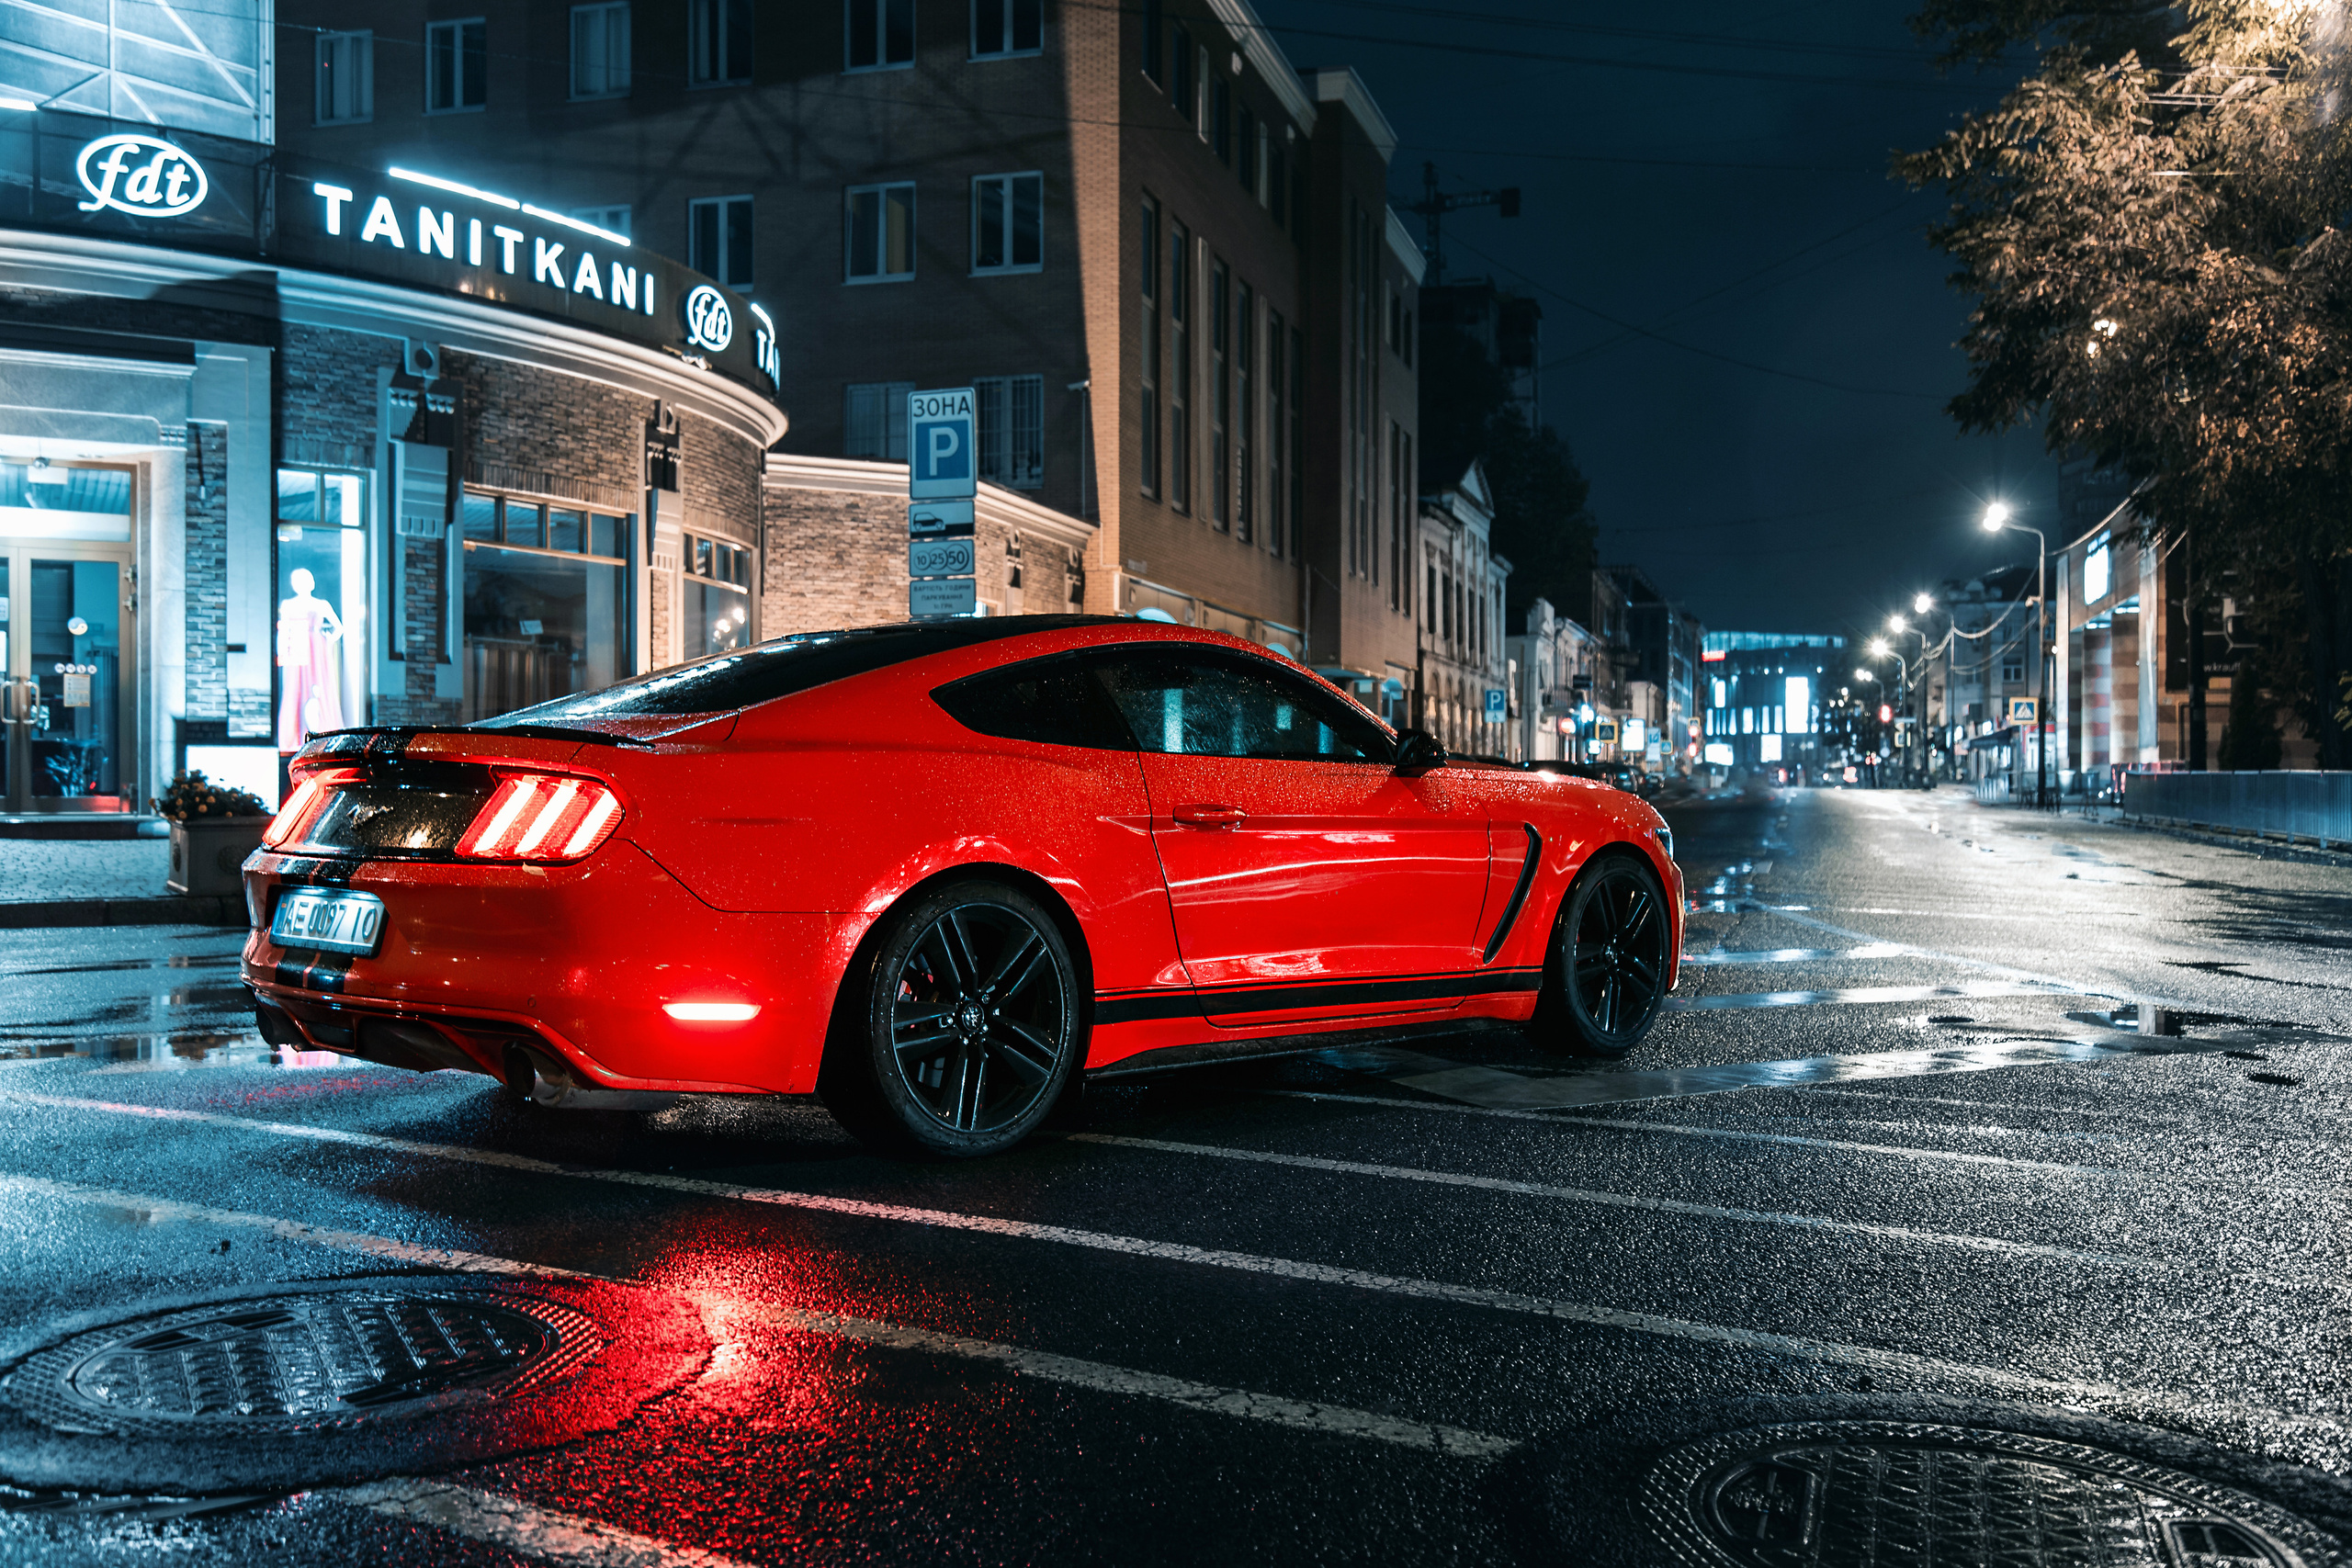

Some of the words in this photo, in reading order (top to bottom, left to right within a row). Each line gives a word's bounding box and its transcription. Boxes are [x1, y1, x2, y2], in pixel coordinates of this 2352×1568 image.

[78, 143, 190, 211] fdt
[313, 182, 654, 316] TANITKANI
[687, 293, 727, 344] fdt
[756, 329, 780, 390] TA
[913, 397, 971, 417] ЗОНА
[929, 426, 959, 476] P
[917, 556, 927, 565] 10
[932, 553, 944, 564] 25
[948, 551, 965, 565] 50
[1490, 692, 1501, 709] P
[282, 900, 309, 935] AE
[308, 901, 347, 939] 0097
